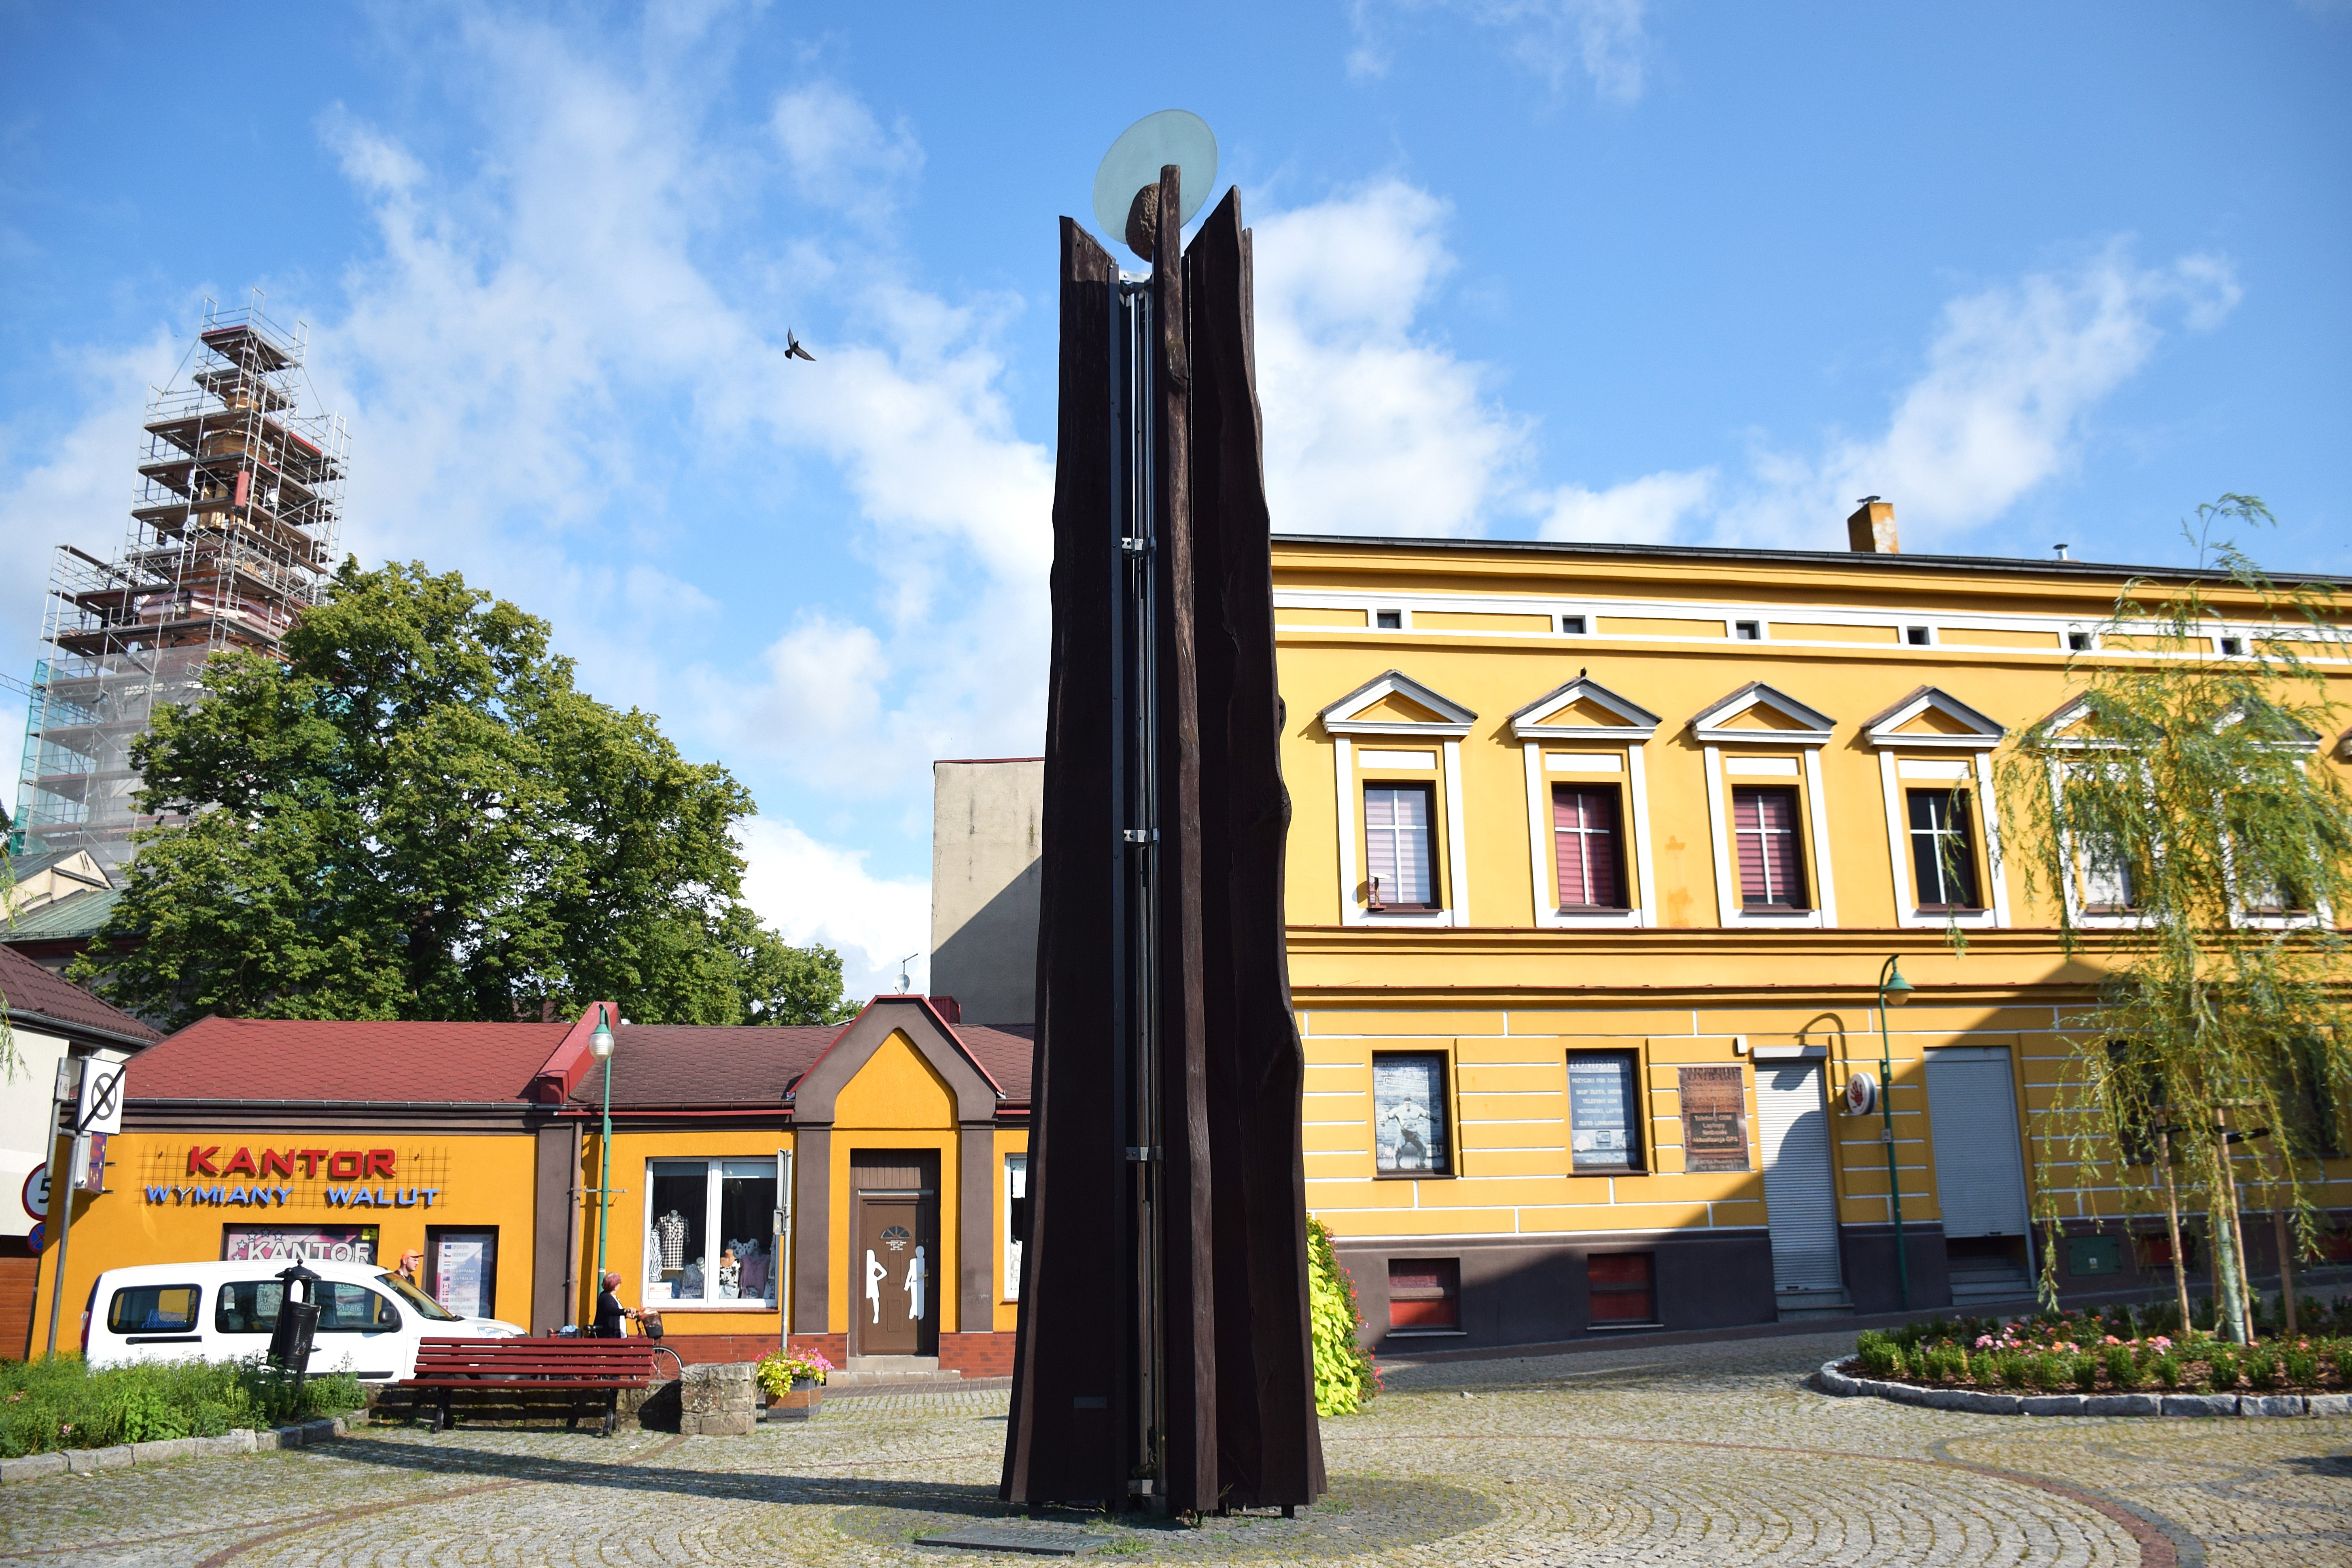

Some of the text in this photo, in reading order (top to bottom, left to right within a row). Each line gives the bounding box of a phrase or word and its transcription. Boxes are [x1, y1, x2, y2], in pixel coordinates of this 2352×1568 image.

[1569, 1059, 1629, 1069] LOMBARD
[189, 1146, 397, 1177] KANTOR
[146, 1185, 440, 1205] WYMIANY WALUT
[248, 1241, 374, 1265] KANTOR
